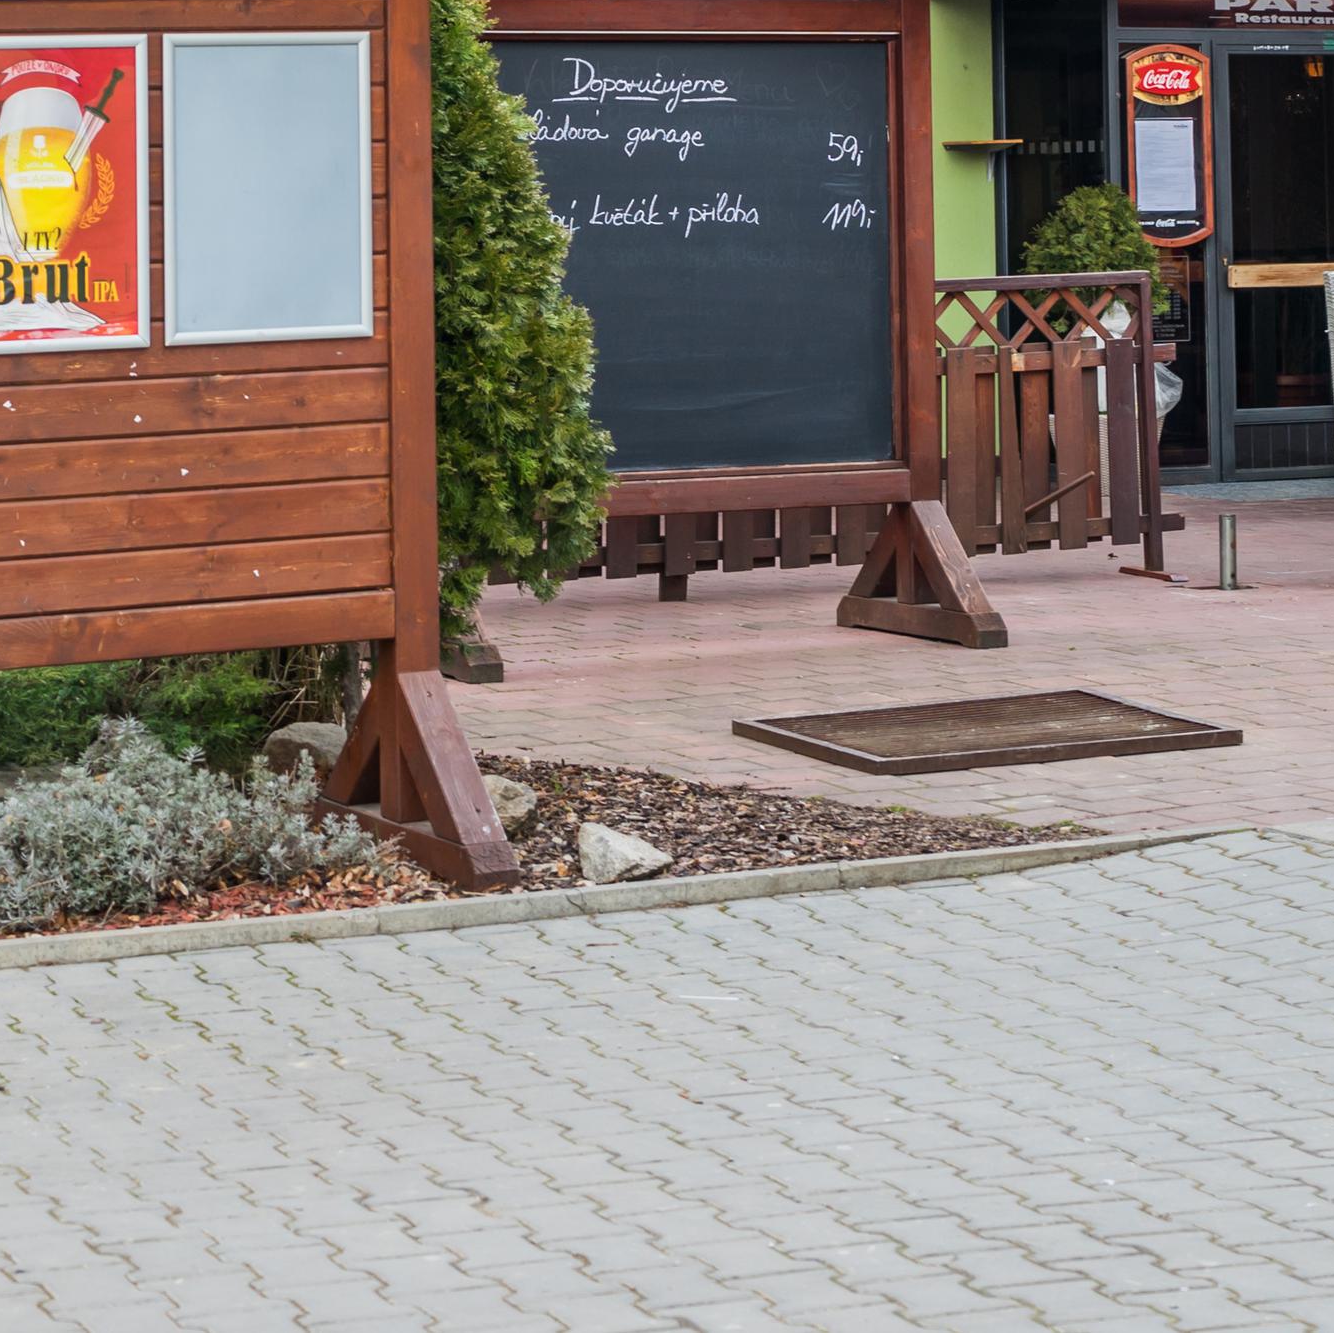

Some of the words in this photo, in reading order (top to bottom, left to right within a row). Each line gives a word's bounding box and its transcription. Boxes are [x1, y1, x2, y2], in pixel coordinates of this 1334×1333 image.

[563, 57, 729, 113] Doporučujeme
[1142, 69, 1192, 90] Coca-Cola
[588, 193, 665, 226] květák
[687, 192, 760, 238] příloha
[93, 281, 120, 303] IPA
